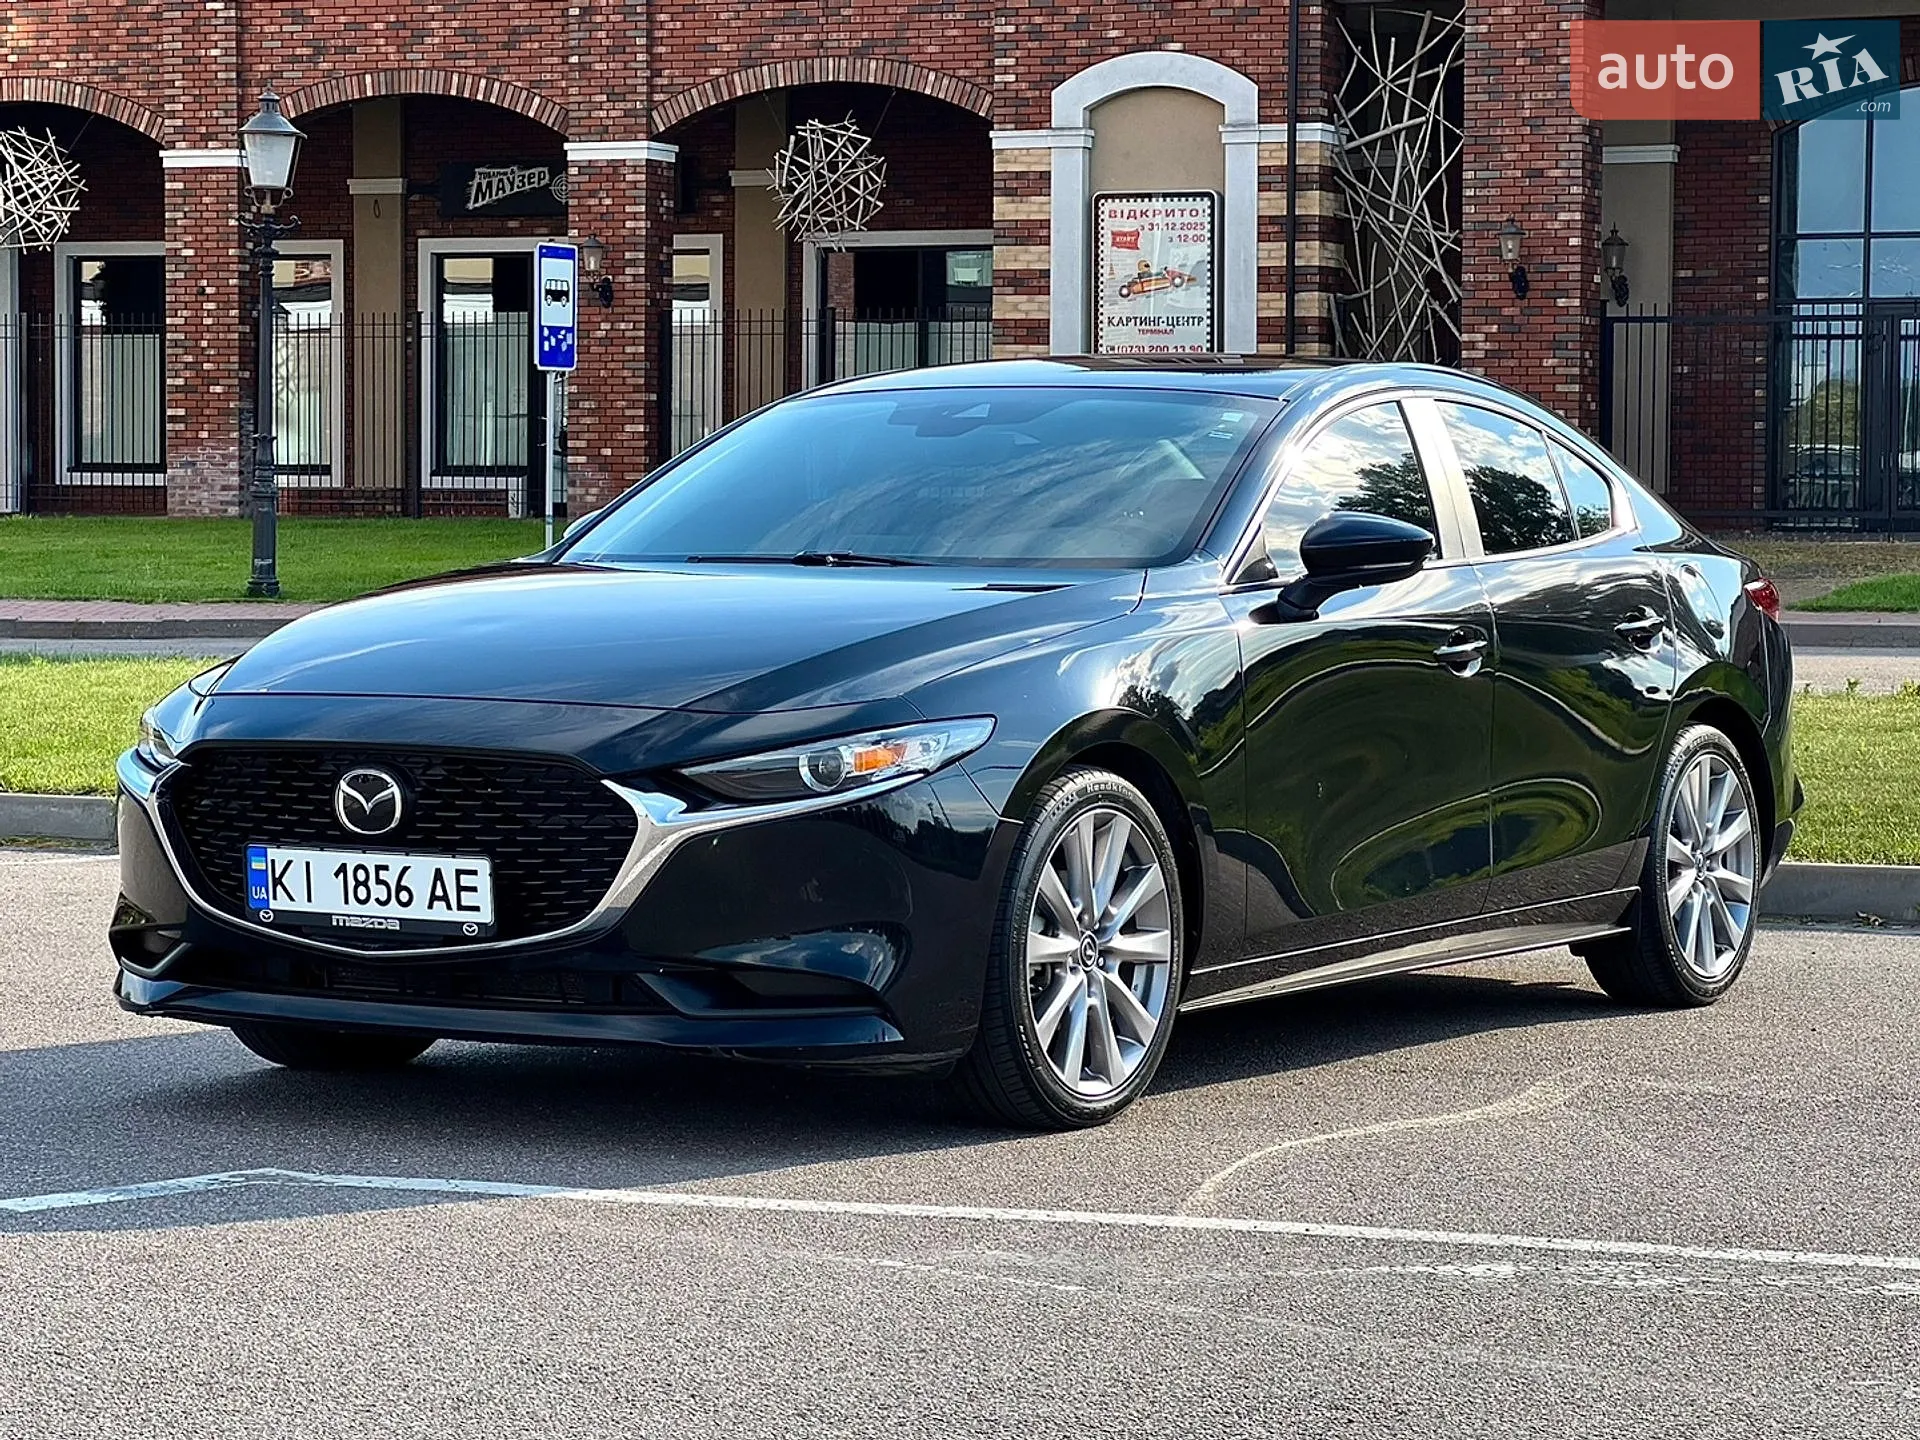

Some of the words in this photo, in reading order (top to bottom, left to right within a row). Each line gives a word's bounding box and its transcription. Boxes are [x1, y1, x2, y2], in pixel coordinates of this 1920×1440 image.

[1108, 208, 1206, 220] ВІДКРИТО!
[1147, 222, 1206, 231] 31.12.2025
[270, 859, 313, 903] KI
[333, 862, 414, 908] 1856
[427, 867, 481, 912] AE
[252, 886, 268, 900] UA
[331, 914, 400, 931] mazda
